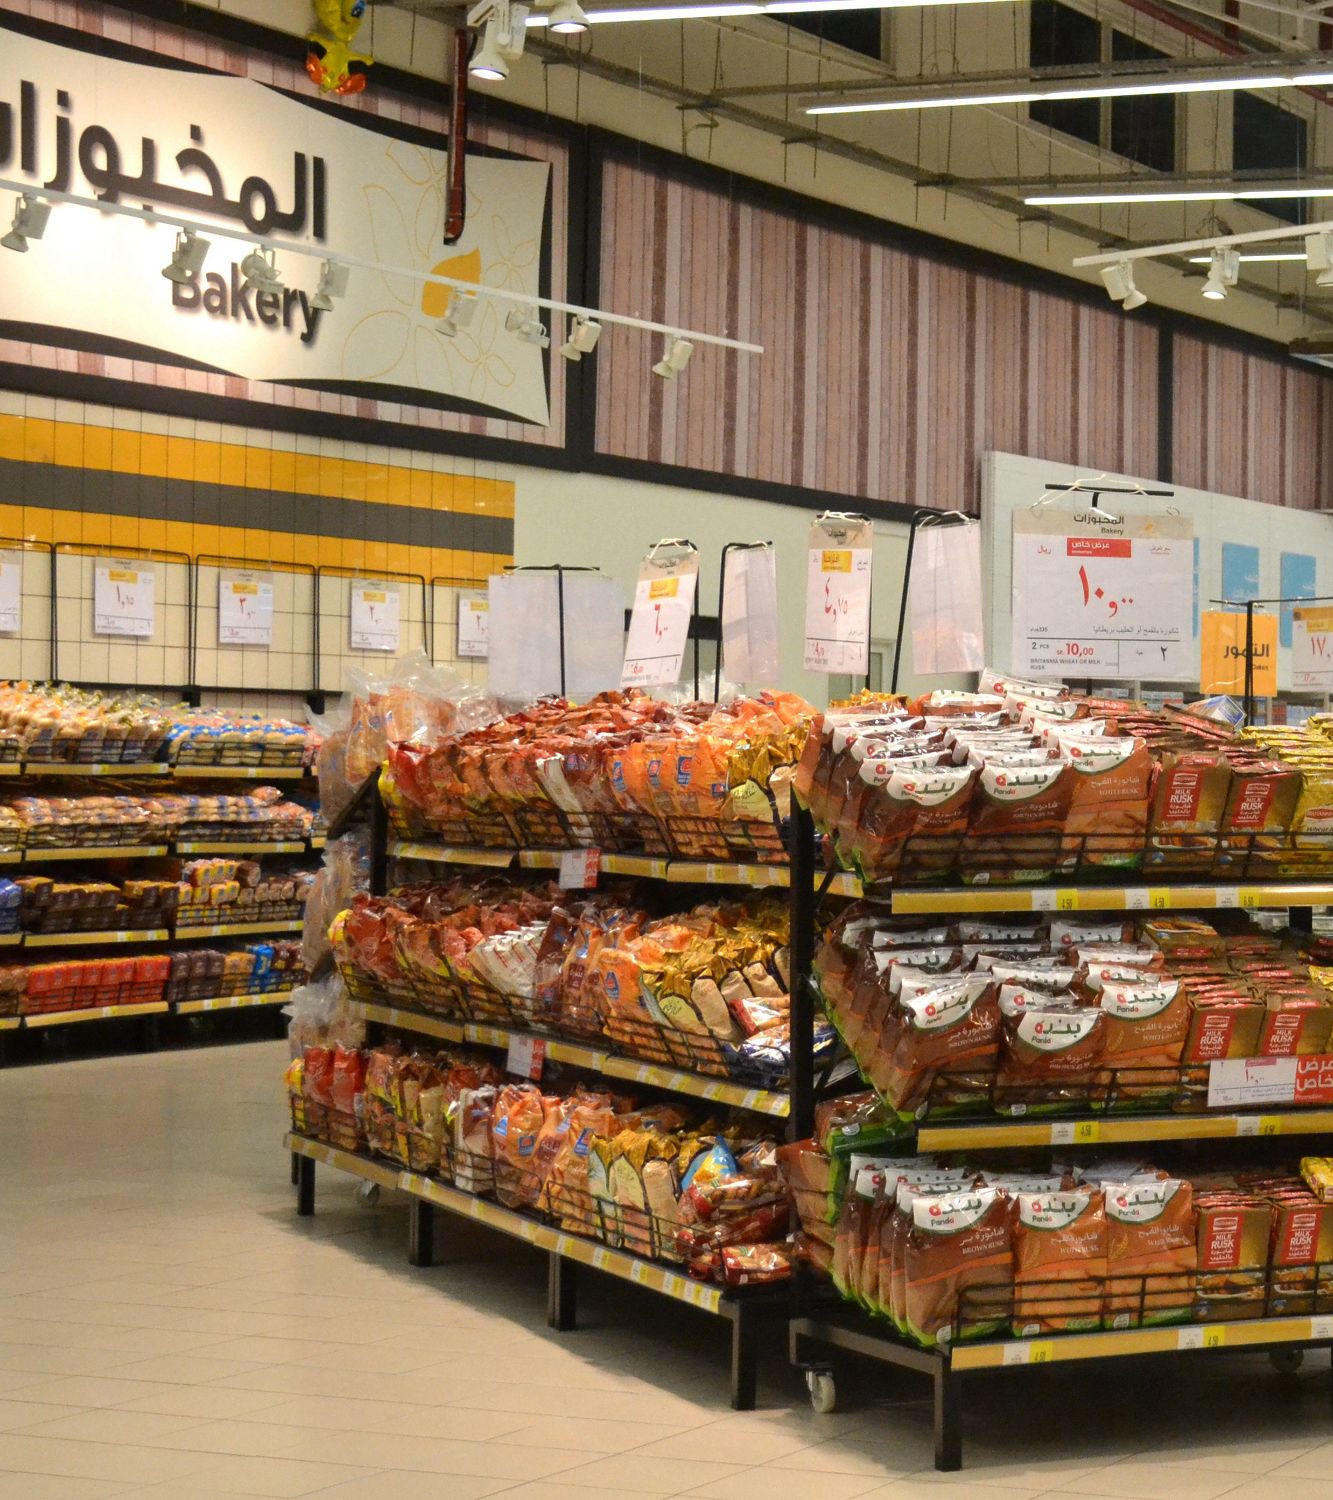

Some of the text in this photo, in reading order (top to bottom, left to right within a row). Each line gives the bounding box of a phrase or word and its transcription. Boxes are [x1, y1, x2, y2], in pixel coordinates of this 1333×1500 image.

[0, 80, 325, 242] المخبوزا
[172, 262, 322, 344] Bakery
[1101, 527, 1125, 536] Bakery
[1071, 540, 1110, 549] عرض خاص
[1031, 641, 1037, 650] 2
[1170, 795, 1194, 804] RUSK
[1241, 802, 1264, 811] RUSK
[1200, 1036, 1225, 1045] RUSK
[1270, 1034, 1295, 1043] RUSK
[1211, 1240, 1235, 1250] RUSK
[1290, 1236, 1313, 1246] RUSK
